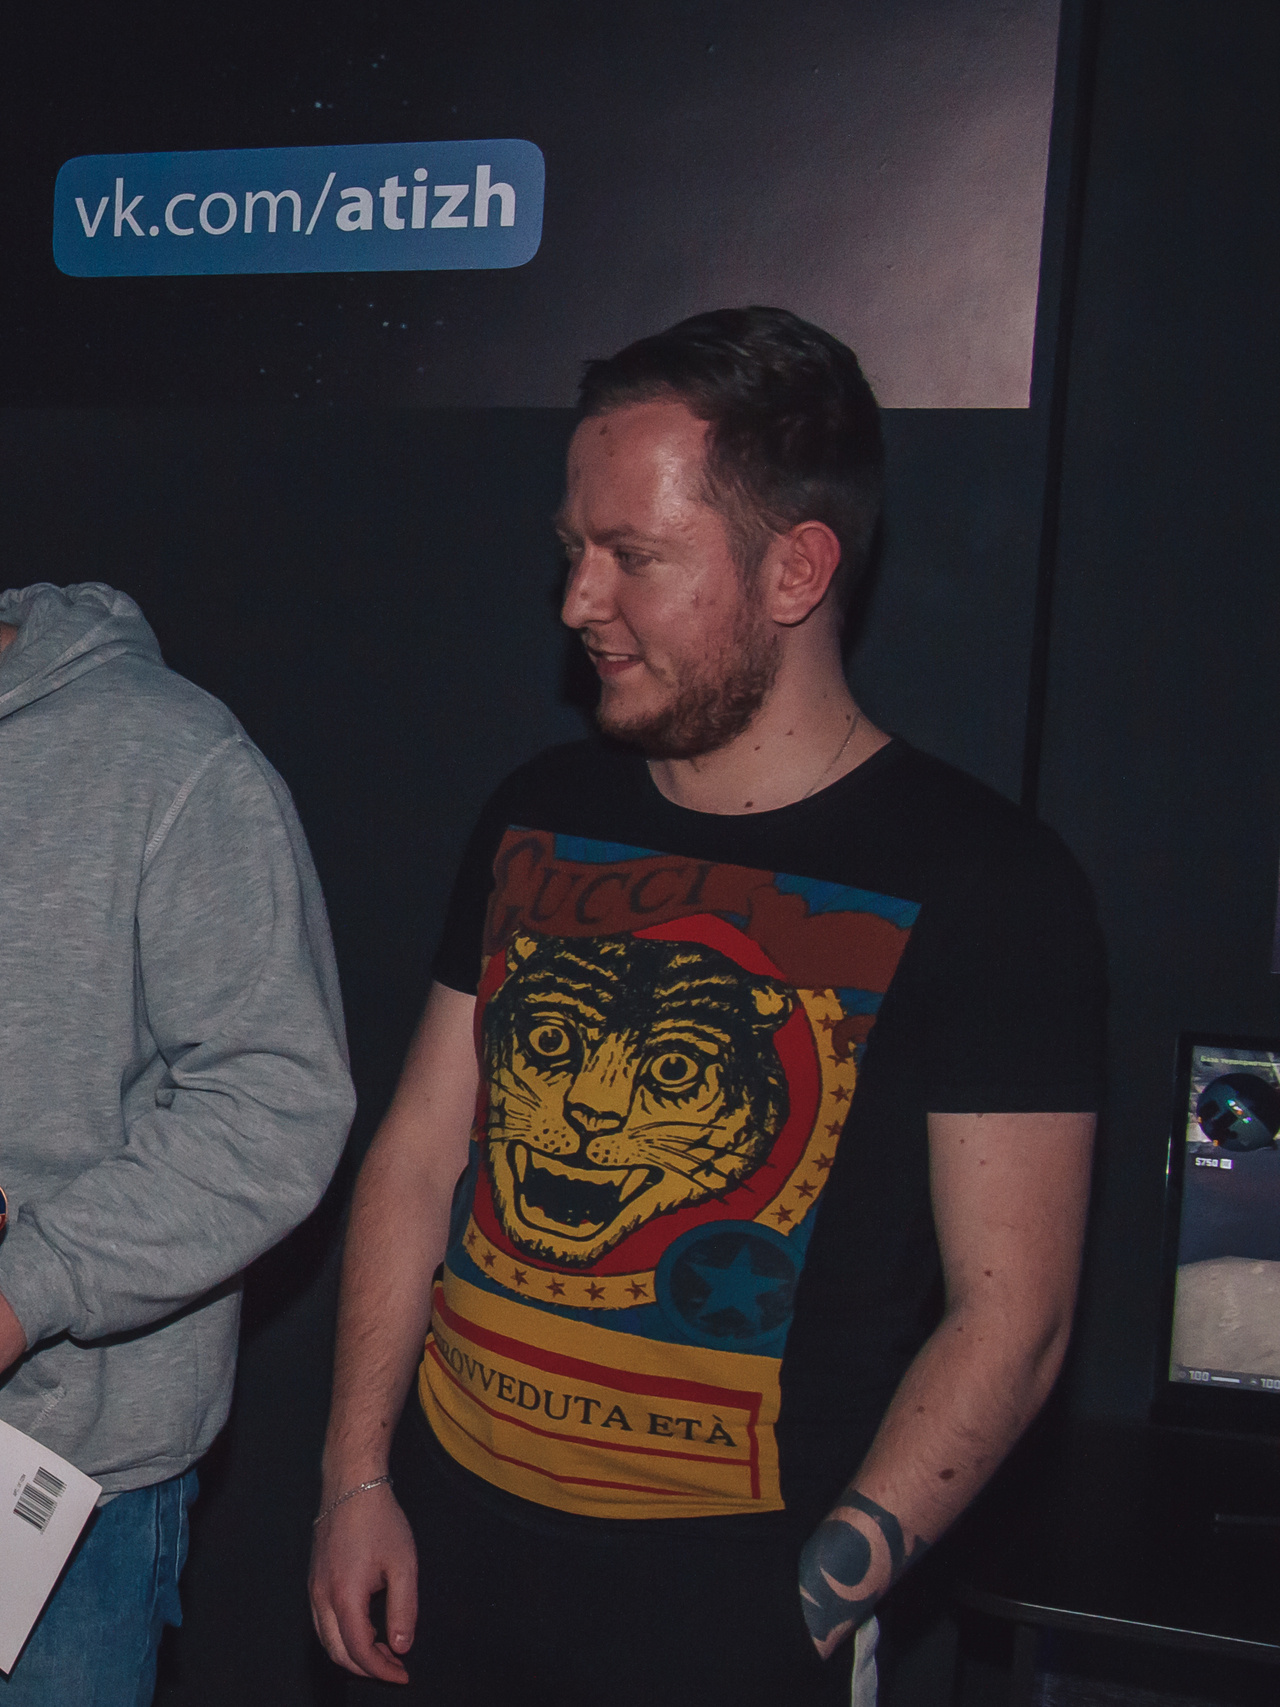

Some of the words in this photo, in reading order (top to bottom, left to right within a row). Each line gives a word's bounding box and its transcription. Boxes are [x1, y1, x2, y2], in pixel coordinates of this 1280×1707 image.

[74, 165, 517, 238] vk.com/atizh
[489, 837, 717, 943] GUCCI
[437, 1337, 633, 1431] ROVVEDUTA
[647, 1413, 738, 1447] ETÀ
